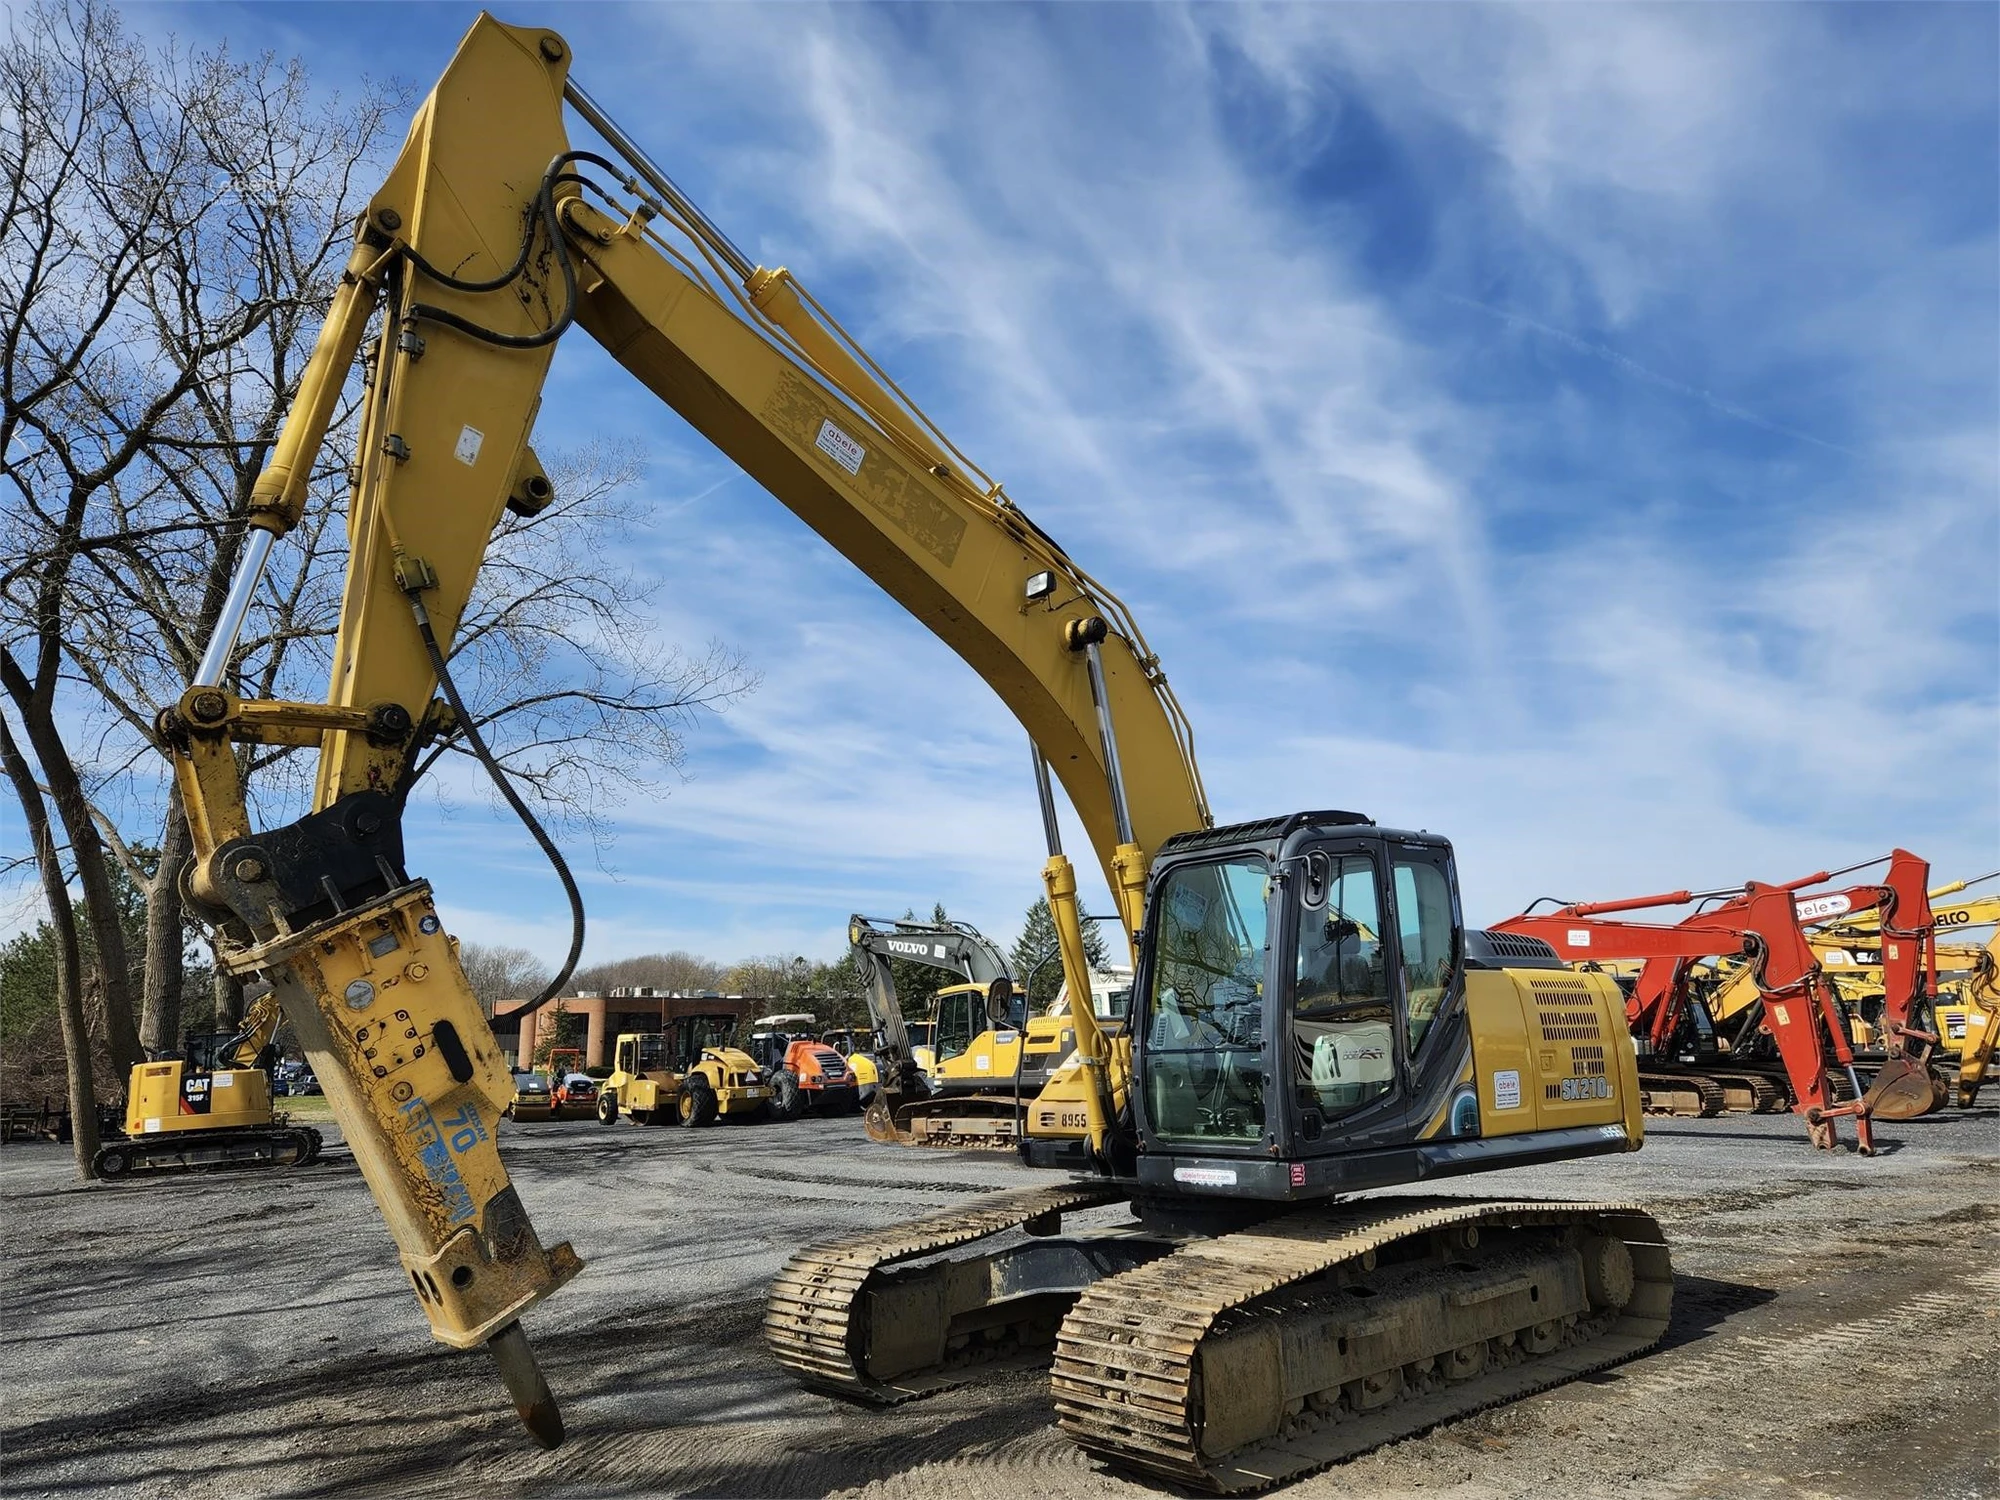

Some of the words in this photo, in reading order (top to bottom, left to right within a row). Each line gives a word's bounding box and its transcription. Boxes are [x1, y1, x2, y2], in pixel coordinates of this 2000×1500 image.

[828, 429, 857, 455] abele
[886, 939, 928, 955] VOLVO
[186, 1078, 210, 1092] CAT
[1562, 1076, 1607, 1101] SK210
[187, 1094, 204, 1102] 315F
[1061, 1113, 1086, 1128] 8955
[442, 1105, 478, 1153] 70
